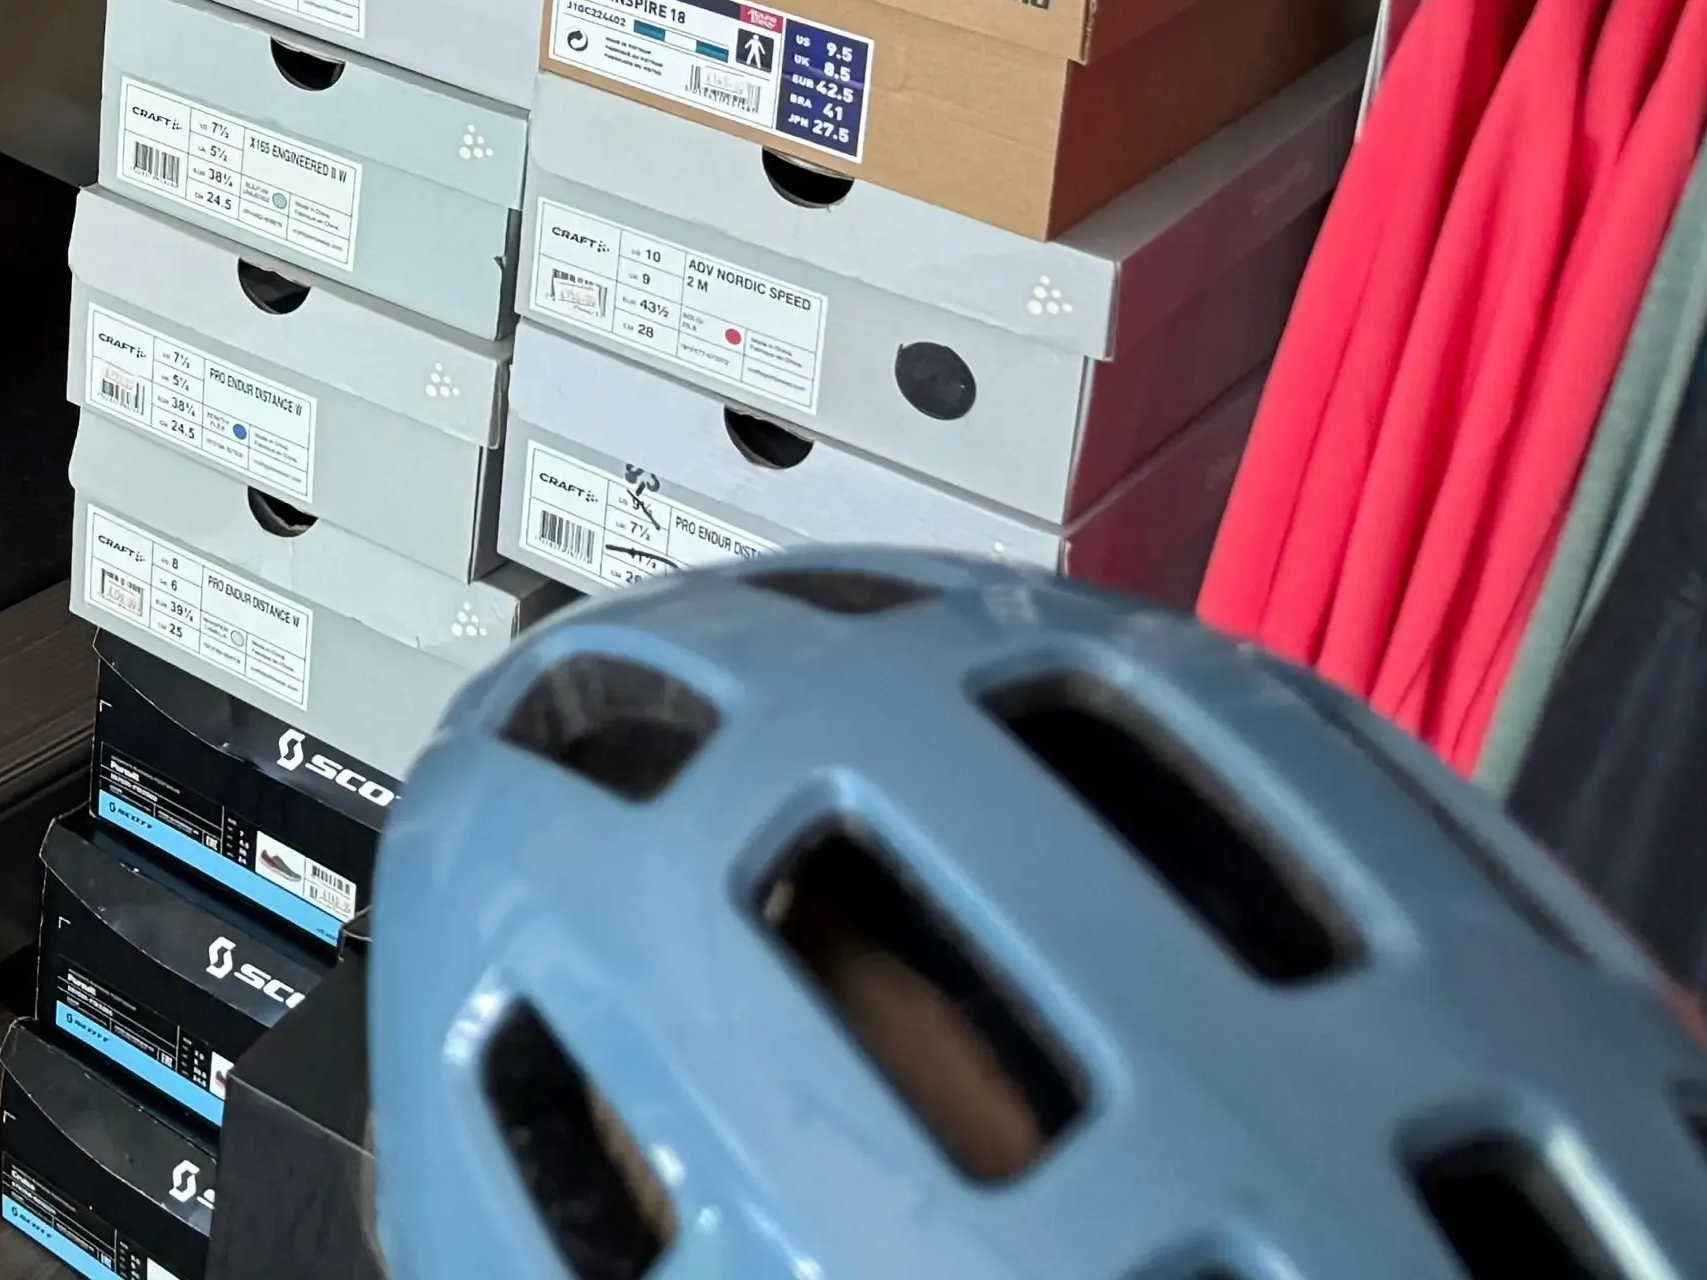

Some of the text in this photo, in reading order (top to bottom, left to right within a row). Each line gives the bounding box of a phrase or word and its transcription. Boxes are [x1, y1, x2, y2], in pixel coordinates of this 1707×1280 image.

[670, 8, 686, 25] 18
[796, 34, 853, 62] US 9.5
[794, 54, 851, 82] UK 8.5
[792, 74, 854, 103] EUR 42.5
[132, 106, 171, 126] CRAFT
[790, 94, 843, 121] BRA 41
[788, 113, 849, 143] JPN 27.5
[250, 137, 329, 176] X165 ENGINEERED
[207, 192, 232, 210] 24.5
[552, 226, 597, 248] CRAFT
[645, 249, 661, 263] 10
[642, 273, 651, 285] 9
[689, 259, 811, 311] ADV NORDIC SPEED
[697, 278, 709, 292] M
[637, 324, 654, 338] 28
[99, 333, 135, 353] CRAFT
[210, 367, 293, 414] PRO ENDUR DISTANCE
[172, 420, 195, 439] 24.5
[539, 472, 584, 497] CRAFT
[676, 516, 732, 551] PRO ENDUR
[98, 535, 136, 557] CRAFT
[208, 576, 290, 623] PRO ENDUR DISTANCE
[169, 624, 183, 638] 25
[305, 753, 402, 807] SCO
